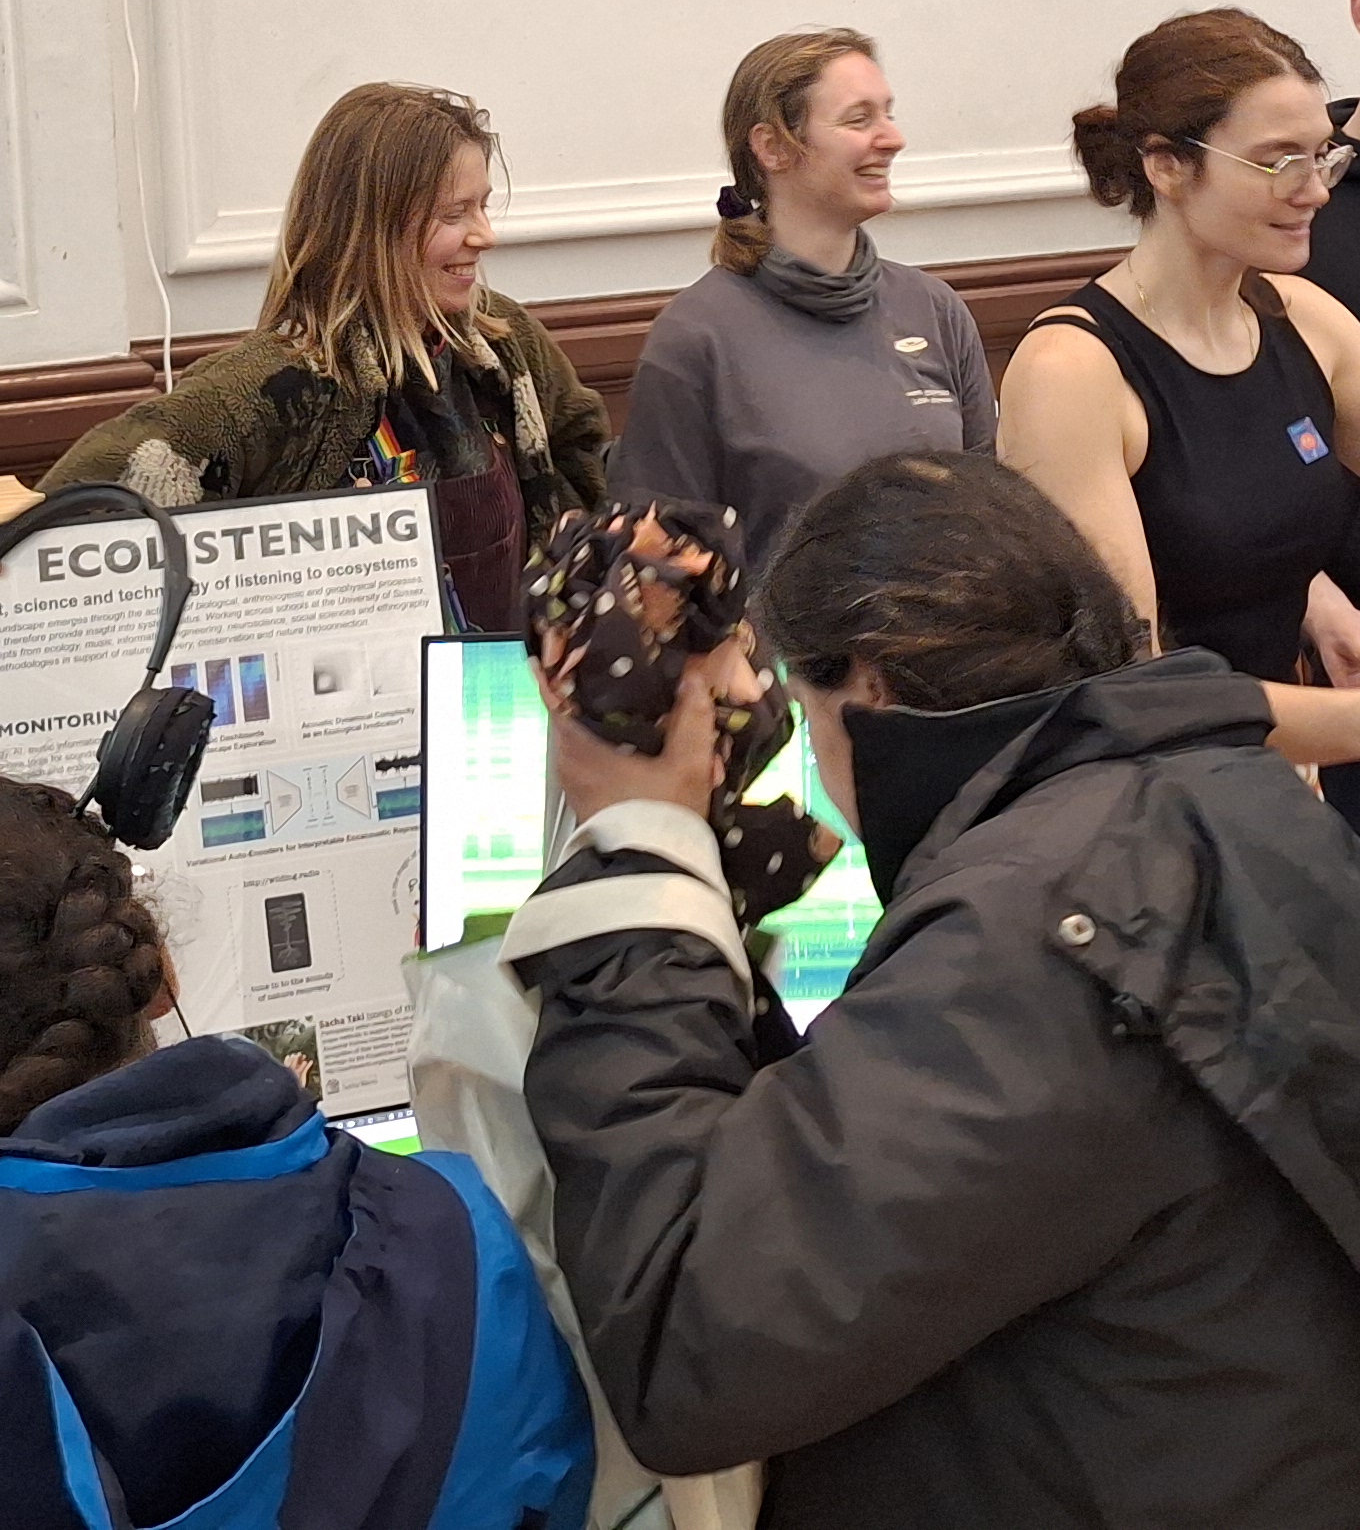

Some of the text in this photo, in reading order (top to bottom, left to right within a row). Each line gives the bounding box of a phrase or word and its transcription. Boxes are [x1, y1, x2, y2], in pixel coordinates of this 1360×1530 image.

[36, 509, 419, 584] ECOLSTENING
[14, 596, 78, 615] science
[83, 589, 114, 607] and
[118, 580, 210, 603] techngy
[214, 575, 231, 591] of
[235, 567, 303, 588] listening
[307, 566, 323, 580] to
[326, 555, 419, 577] ecosystems
[90, 611, 126, 623] through
[128, 609, 143, 618] the
[3, 634, 47, 646] therefore
[48, 629, 84, 642] provide
[20, 647, 42, 657] from
